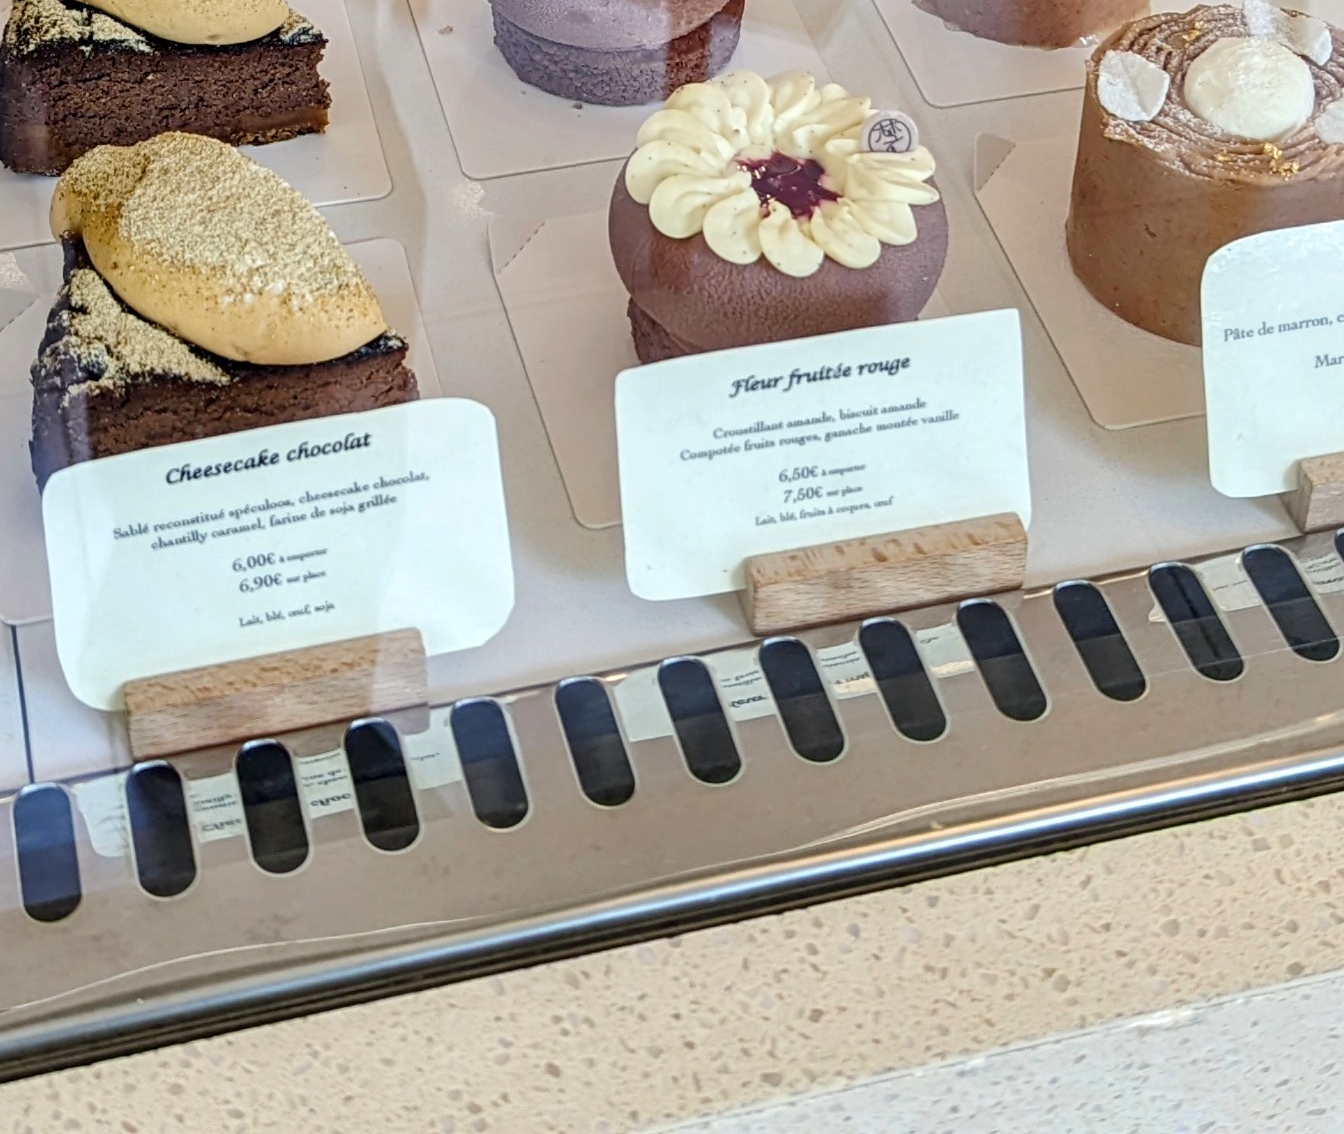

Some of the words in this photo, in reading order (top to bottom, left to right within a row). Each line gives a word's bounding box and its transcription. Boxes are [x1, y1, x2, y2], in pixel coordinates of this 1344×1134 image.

[1223, 327, 1255, 343] Pâte
[1257, 320, 1275, 337] de
[1277, 316, 1334, 334] marron,
[728, 374, 786, 399] Fleur
[782, 362, 852, 393] fruitée
[856, 356, 911, 377] rouge
[679, 443, 742, 462] Compotée
[743, 437, 776, 452] fruits
[778, 433, 822, 447] rouges,
[823, 422, 873, 443] ganache
[875, 416, 919, 432] montée
[920, 408, 960, 425] vanille
[712, 420, 784, 440] Croustillant
[785, 411, 836, 429] amande,
[838, 405, 879, 421] biscuit
[880, 397, 927, 415] amande
[165, 448, 280, 485] Cheesecake
[286, 432, 372, 463] chocolat
[778, 465, 819, 483] 6,50€
[112, 522, 150, 541] Sablé
[153, 508, 226, 533] reconstitué
[228, 498, 296, 521] spéculoos,
[298, 481, 370, 508] cheesecake
[372, 470, 431, 490] chocolat,
[783, 485, 824, 504] 7,50€
[150, 529, 208, 551] chantilly
[211, 518, 266, 539] caramel,
[268, 512, 308, 528] farine
[309, 505, 327, 520] de
[328, 501, 356, 516] soja
[357, 493, 398, 514] grillée
[231, 552, 276, 573] 6,00€
[238, 572, 283, 593] 6,90€
